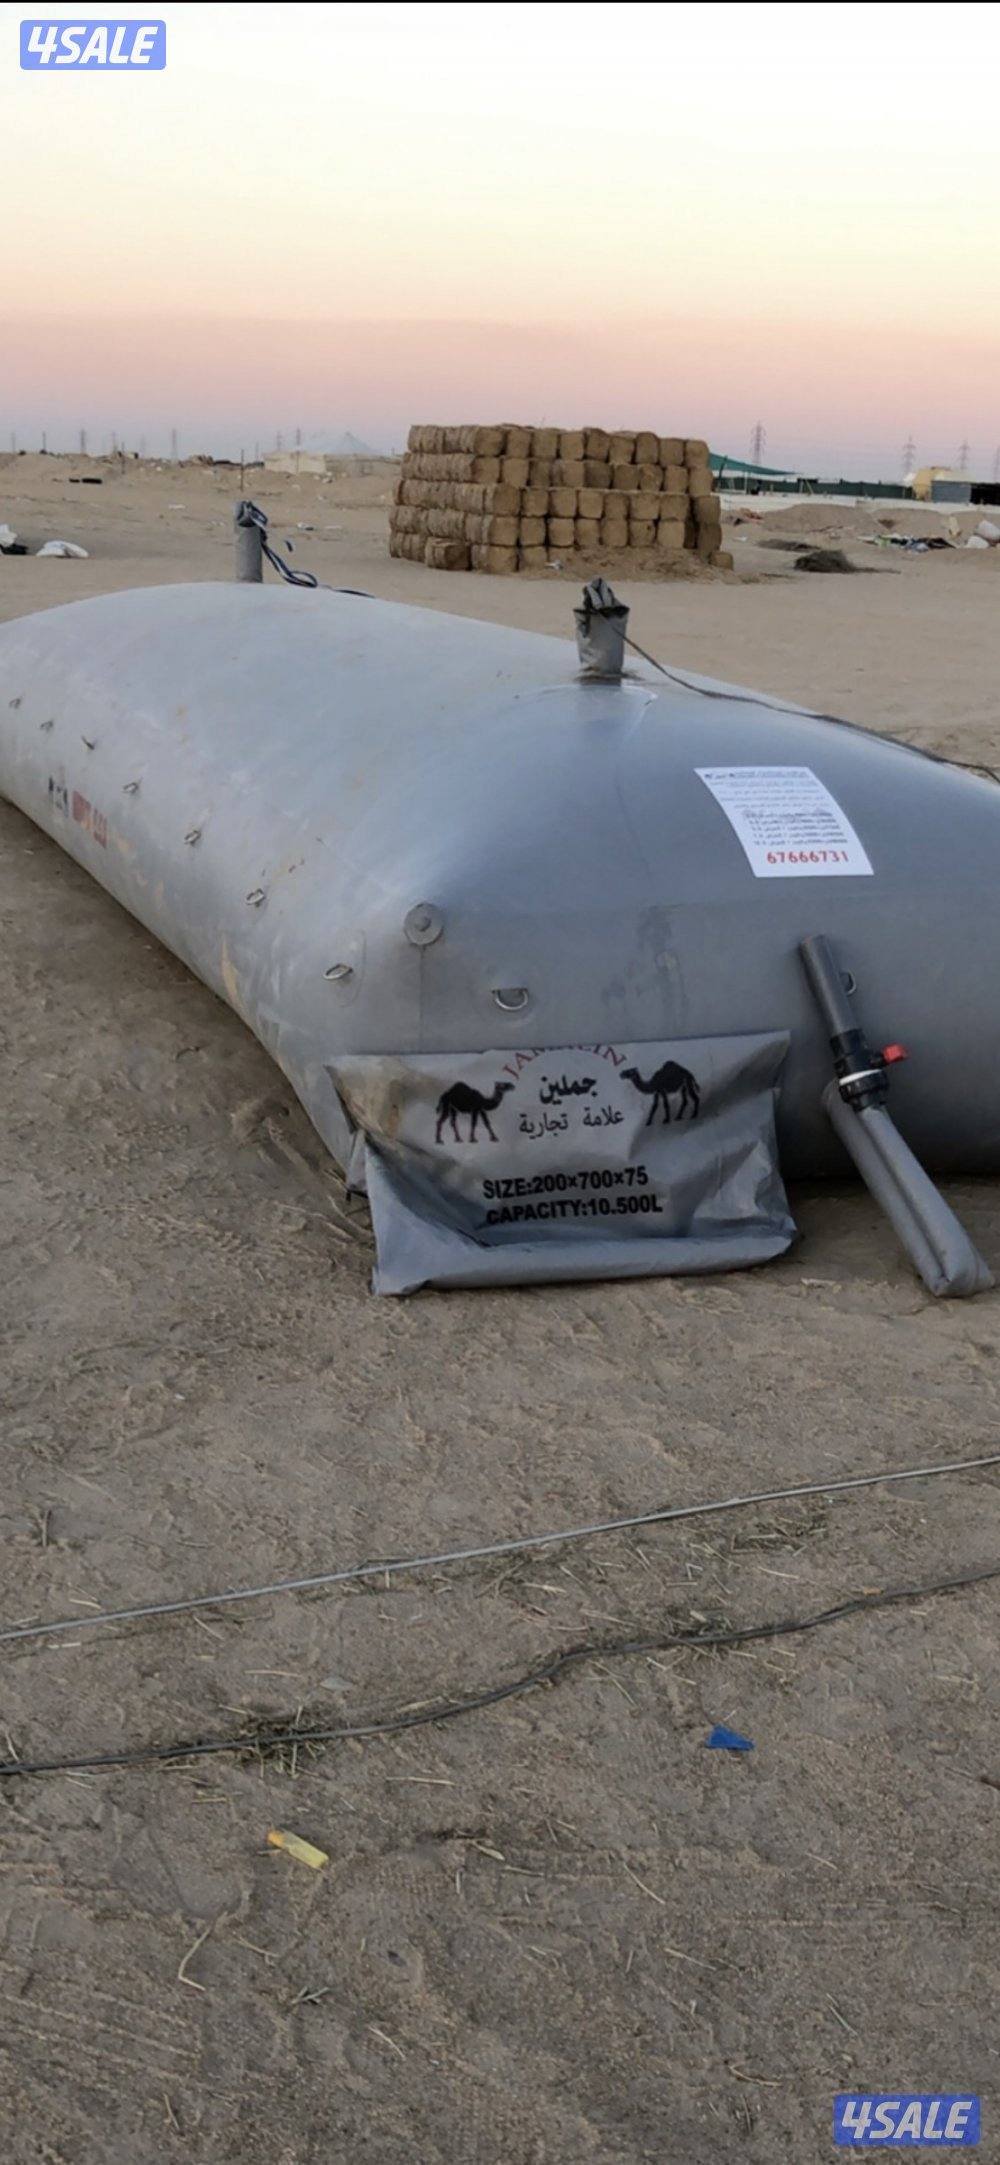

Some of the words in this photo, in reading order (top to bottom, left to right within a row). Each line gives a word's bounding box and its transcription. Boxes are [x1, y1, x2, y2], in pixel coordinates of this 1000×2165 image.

[766, 850, 849, 864] 67666731
[539, 1074, 599, 1105] جملين
[519, 1112, 569, 1139] تجارية
[583, 1104, 625, 1127] علامة
[486, 1194, 664, 1226] CAPACITY:10.500L
